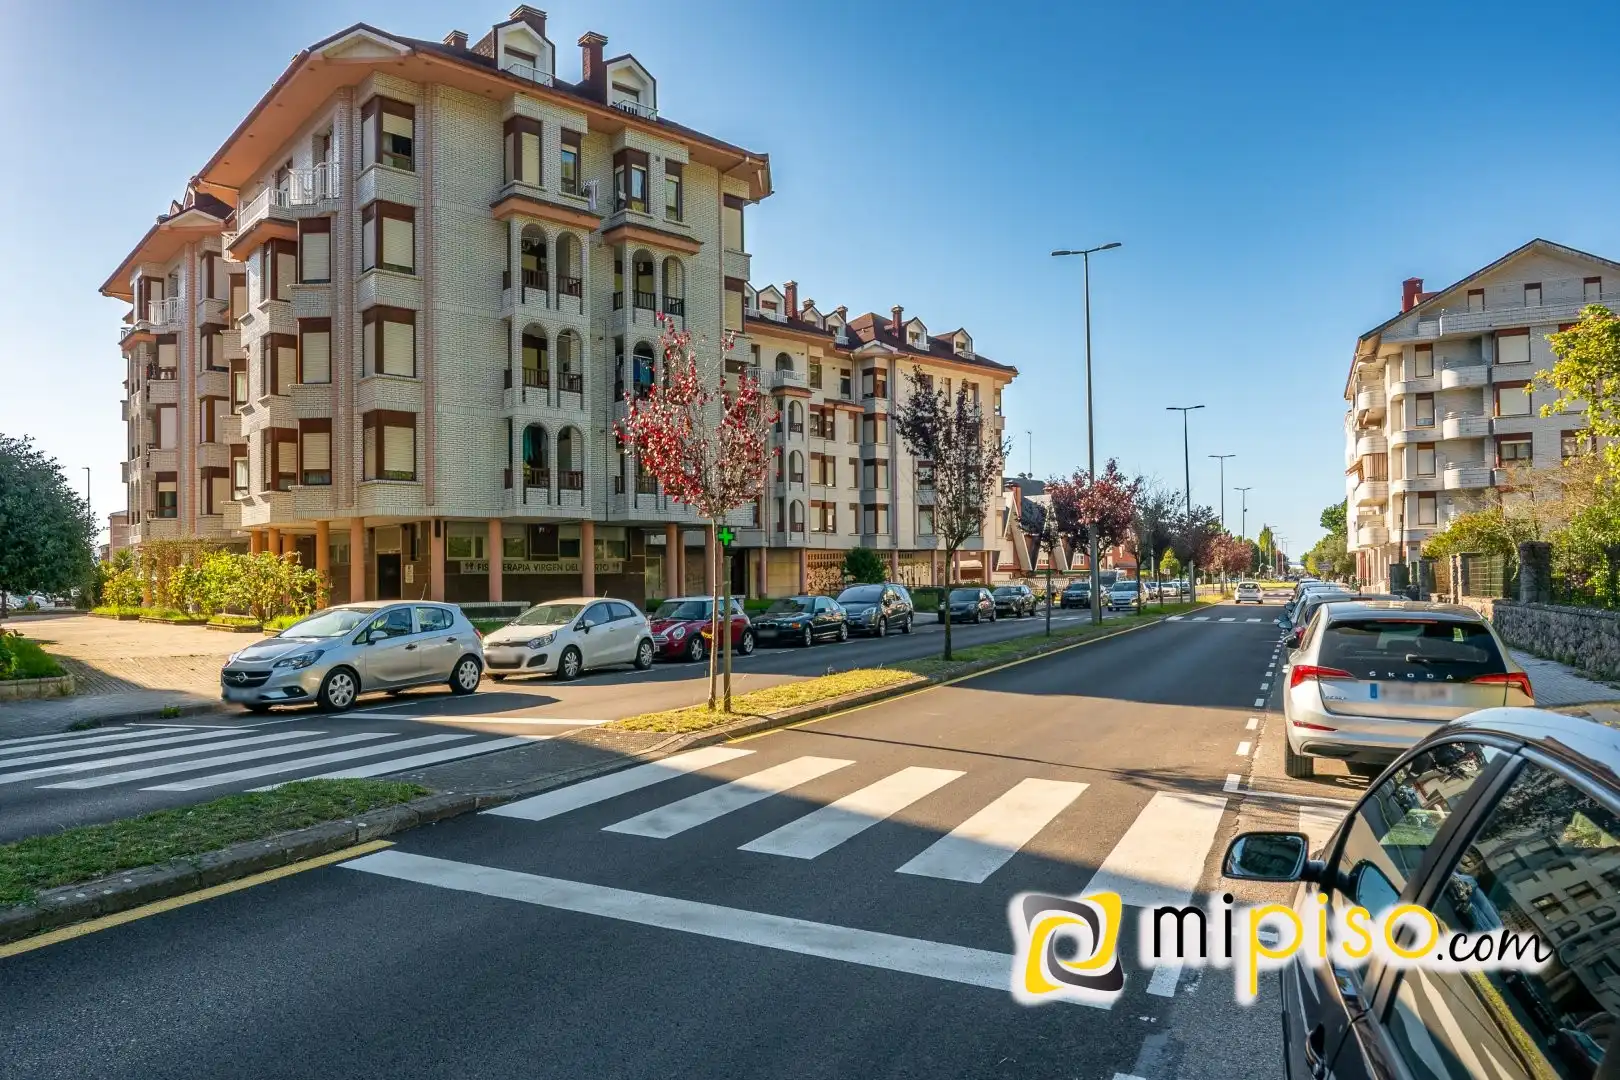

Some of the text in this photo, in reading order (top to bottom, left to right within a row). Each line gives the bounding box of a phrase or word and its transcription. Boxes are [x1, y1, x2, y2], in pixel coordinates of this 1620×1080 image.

[477, 563, 530, 572] FISERAPIA
[533, 563, 563, 572] VIRGEN
[565, 563, 579, 572] DEL
